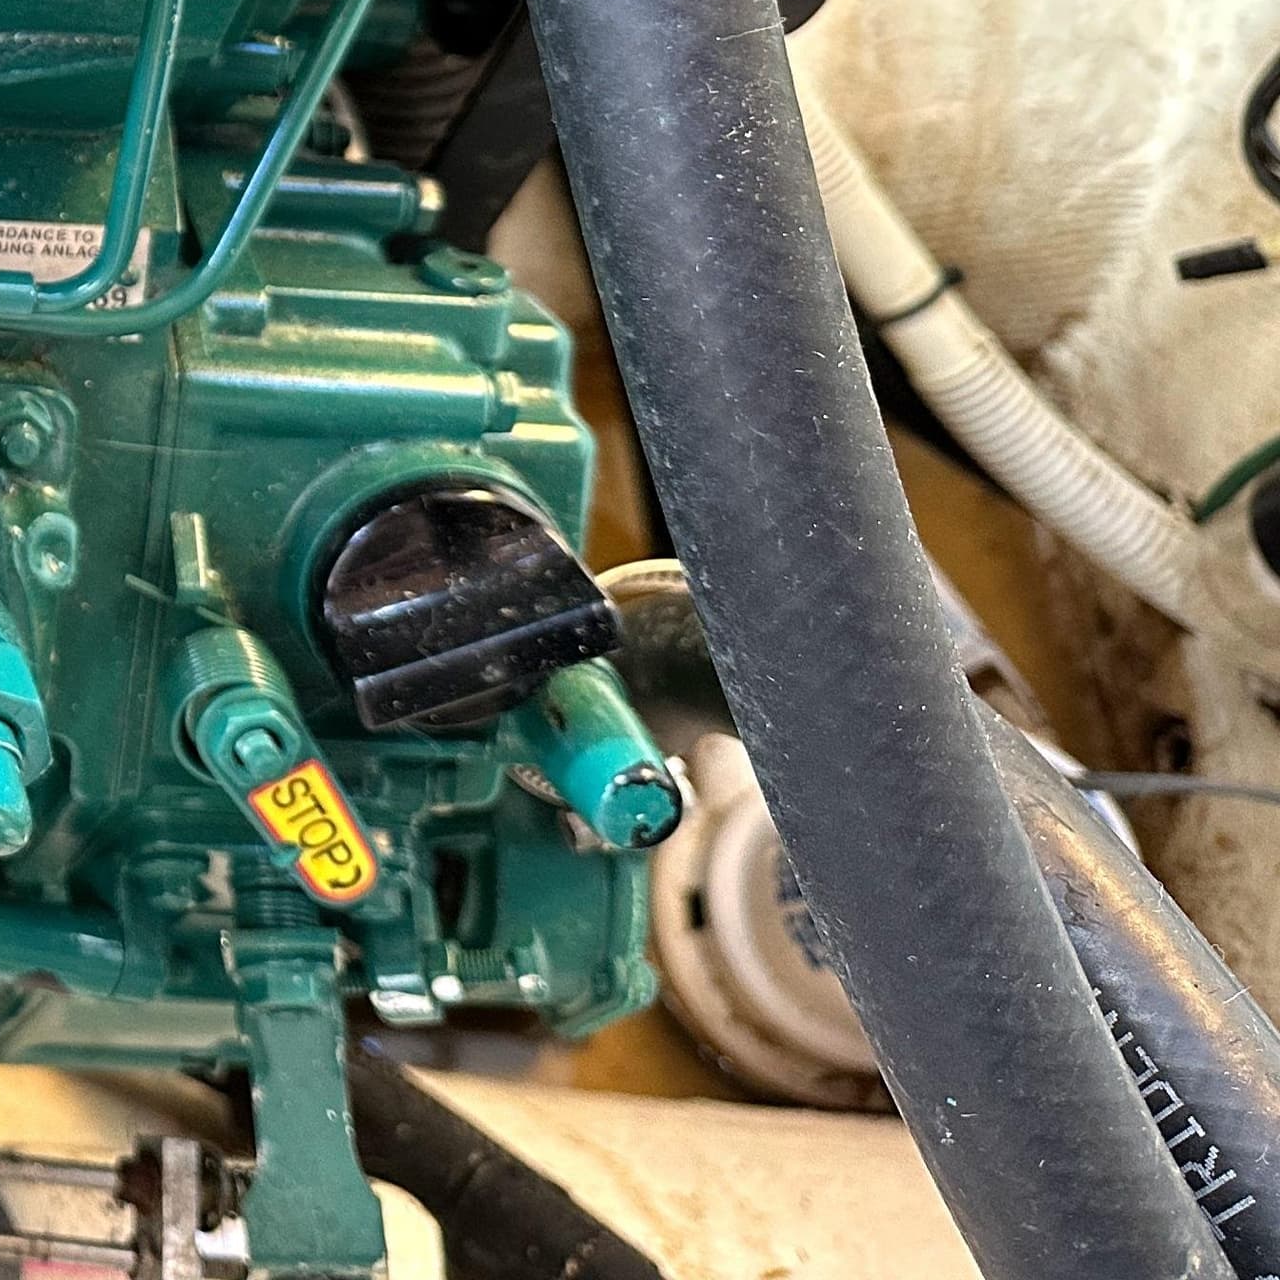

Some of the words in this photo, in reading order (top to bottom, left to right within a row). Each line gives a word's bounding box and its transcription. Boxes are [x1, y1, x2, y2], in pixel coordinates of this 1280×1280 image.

[74, 230, 96, 243] TO
[41, 243, 100, 258] ANLAG
[270, 776, 353, 868] STOP
